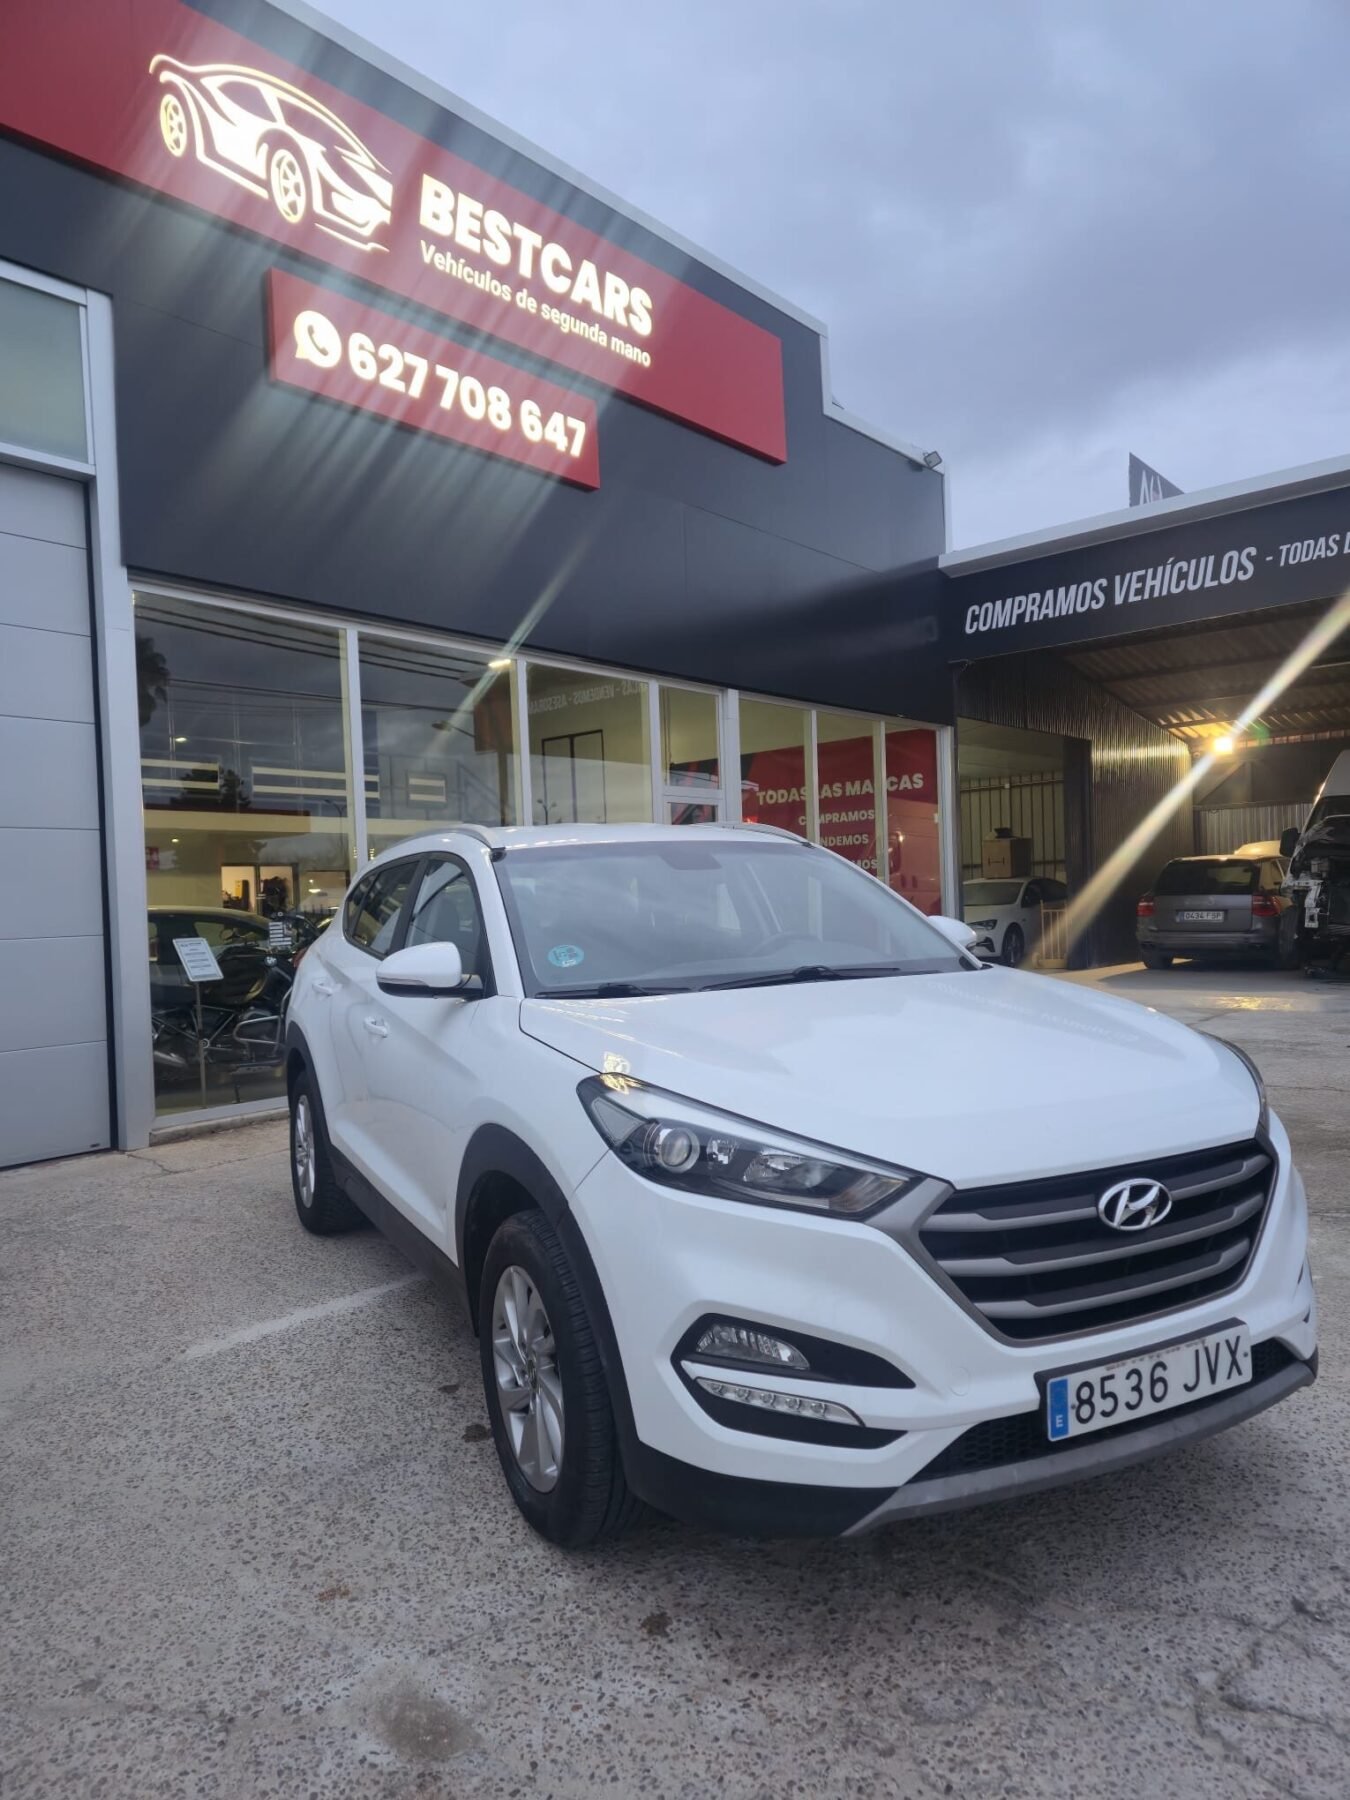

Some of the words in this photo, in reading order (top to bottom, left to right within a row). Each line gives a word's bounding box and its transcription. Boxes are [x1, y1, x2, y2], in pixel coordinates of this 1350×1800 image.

[419, 173, 652, 336] BESTCARS
[420, 239, 511, 302] Vehículos
[516, 288, 538, 313] de
[541, 302, 608, 347] segunda
[611, 335, 651, 368] mano
[348, 332, 428, 398] 627
[435, 364, 512, 431] 708
[520, 399, 586, 457] 647
[965, 578, 1107, 634] COMPRAMOS
[1114, 546, 1257, 605] VEHÍCULOS
[1279, 533, 1340, 567] TODAS
[798, 809, 875, 826] CMPRAMOS
[819, 783, 843, 799] AS
[845, 773, 924, 797] MACAS
[821, 833, 870, 847] NDEMOS
[1055, 1414, 1063, 1428] E
[1075, 1361, 1168, 1424] 8536
[1183, 1335, 1243, 1393] JVX
